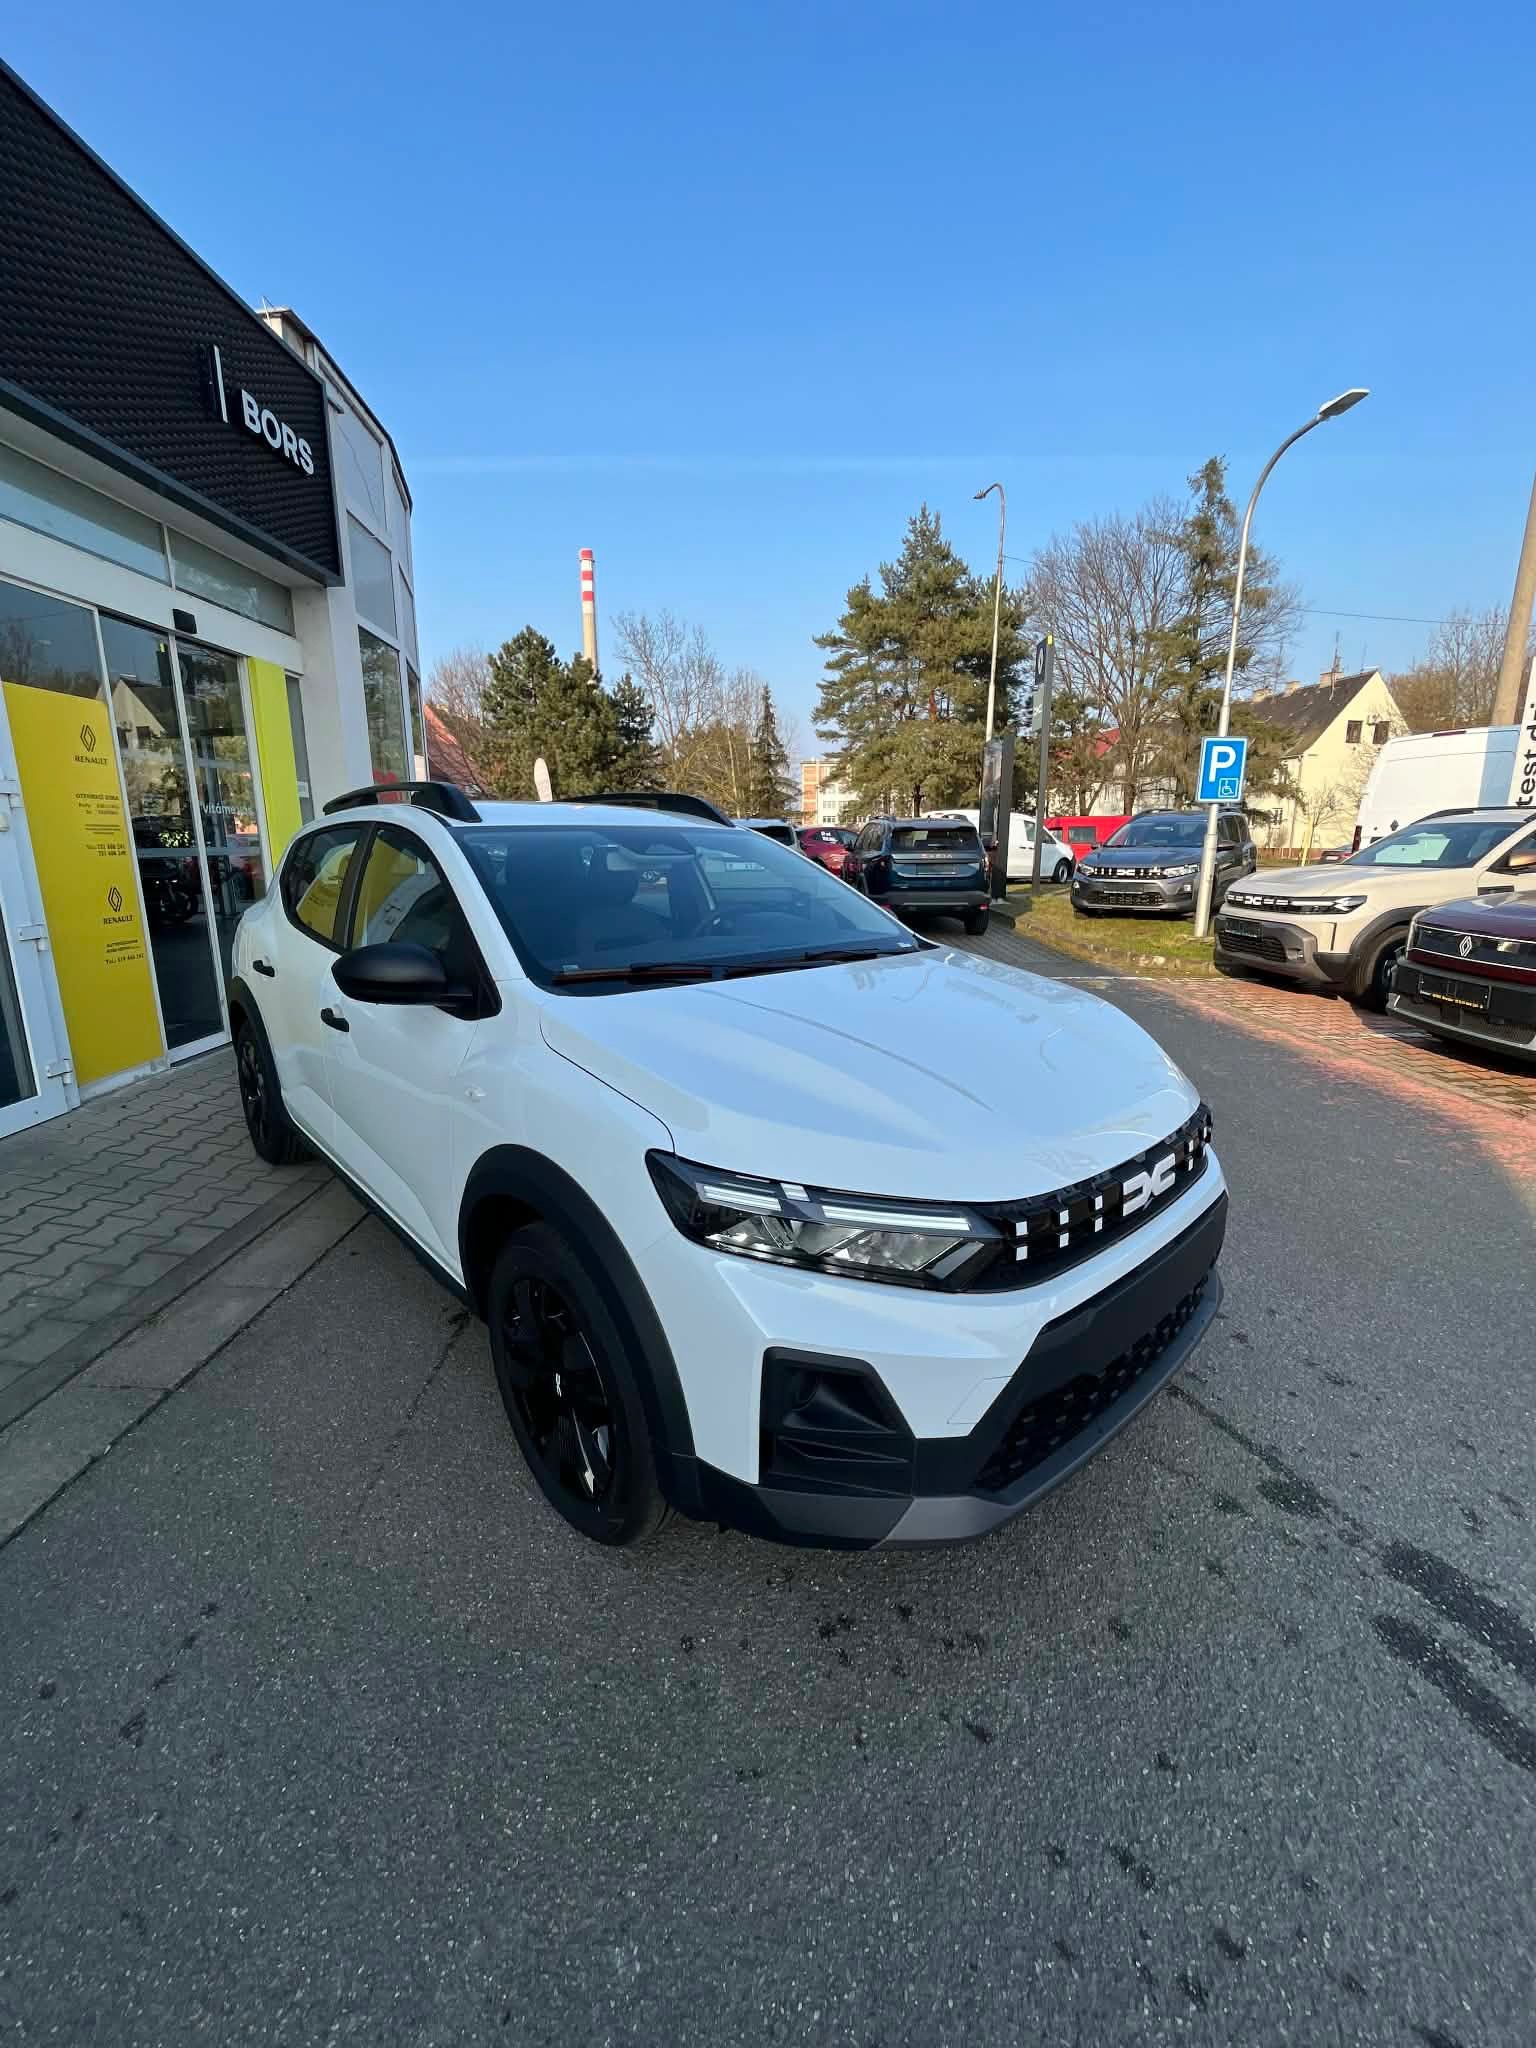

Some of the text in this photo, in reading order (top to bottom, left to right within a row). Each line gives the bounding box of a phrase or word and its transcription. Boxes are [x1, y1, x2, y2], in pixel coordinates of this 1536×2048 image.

[241, 389, 314, 475] BORS
[74, 754, 108, 765] RENAULT
[1208, 745, 1236, 783] P
[1516, 749, 1536, 806] test
[103, 914, 135, 925] RENAULT
